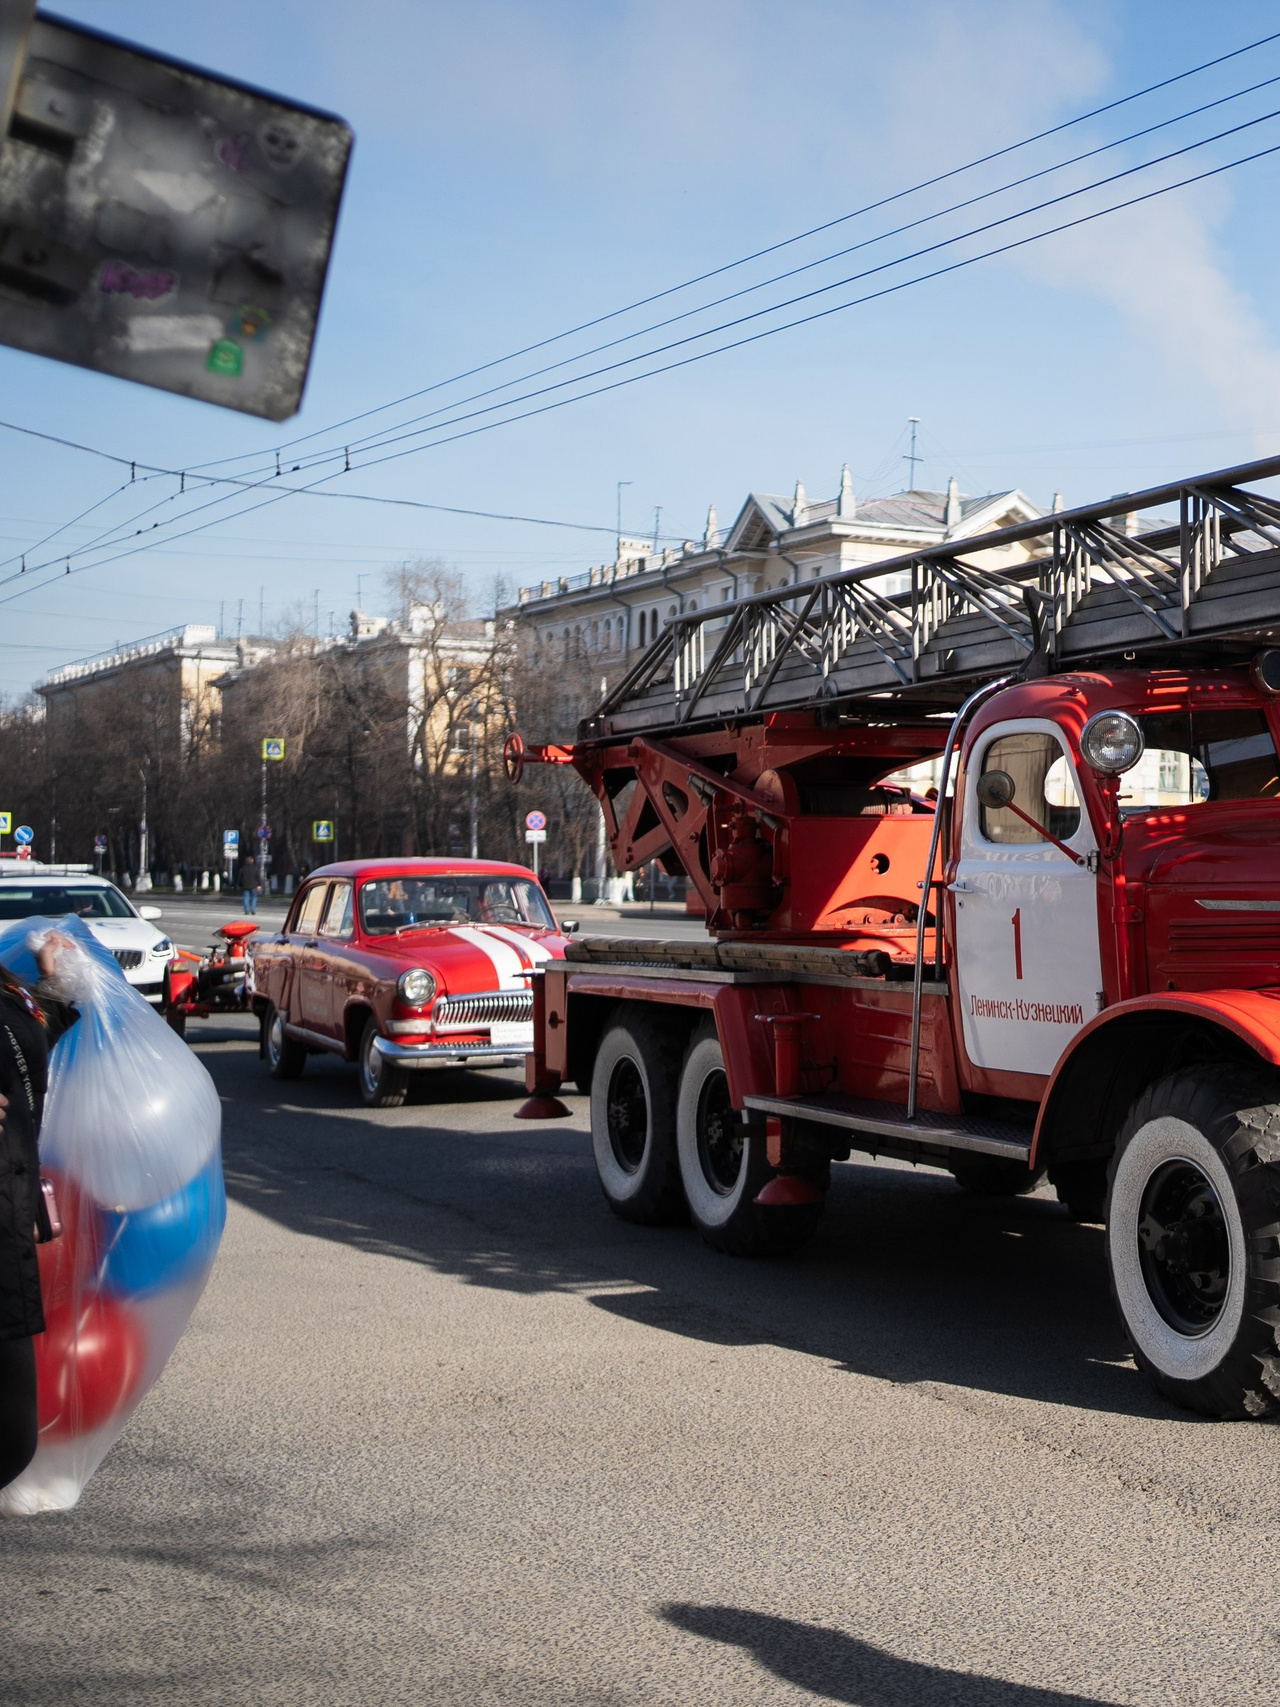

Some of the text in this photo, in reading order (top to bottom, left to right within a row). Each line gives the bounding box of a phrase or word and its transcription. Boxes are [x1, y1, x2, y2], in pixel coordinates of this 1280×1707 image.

[228, 832, 236, 842] P
[1011, 907, 1023, 980] 1
[971, 995, 1084, 1024] Ленинск-Кузнецкий
[22, 1074, 36, 1111] YOUNG
